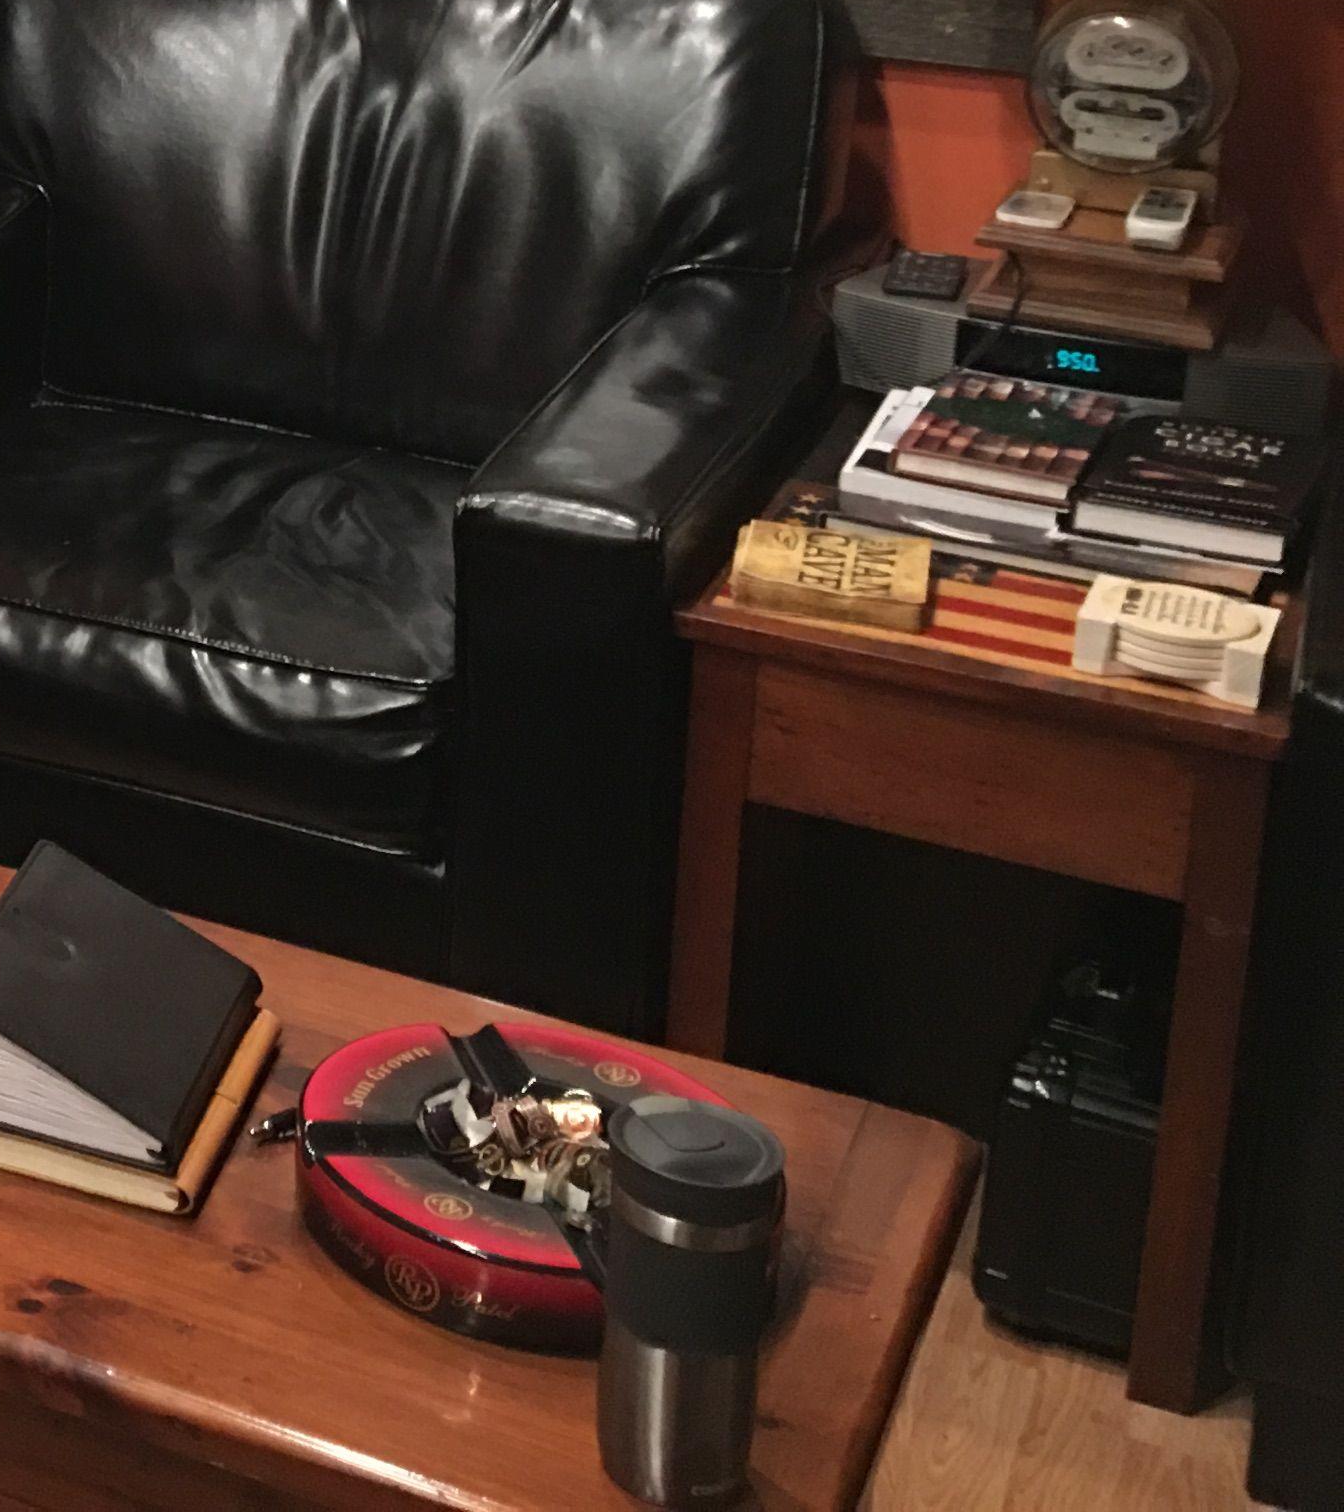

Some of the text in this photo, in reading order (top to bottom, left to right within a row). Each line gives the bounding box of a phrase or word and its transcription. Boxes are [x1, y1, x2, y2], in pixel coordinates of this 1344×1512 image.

[799, 531, 851, 589] CAVE
[850, 546, 897, 595] MAN
[343, 1047, 431, 1108] Sun Grown
